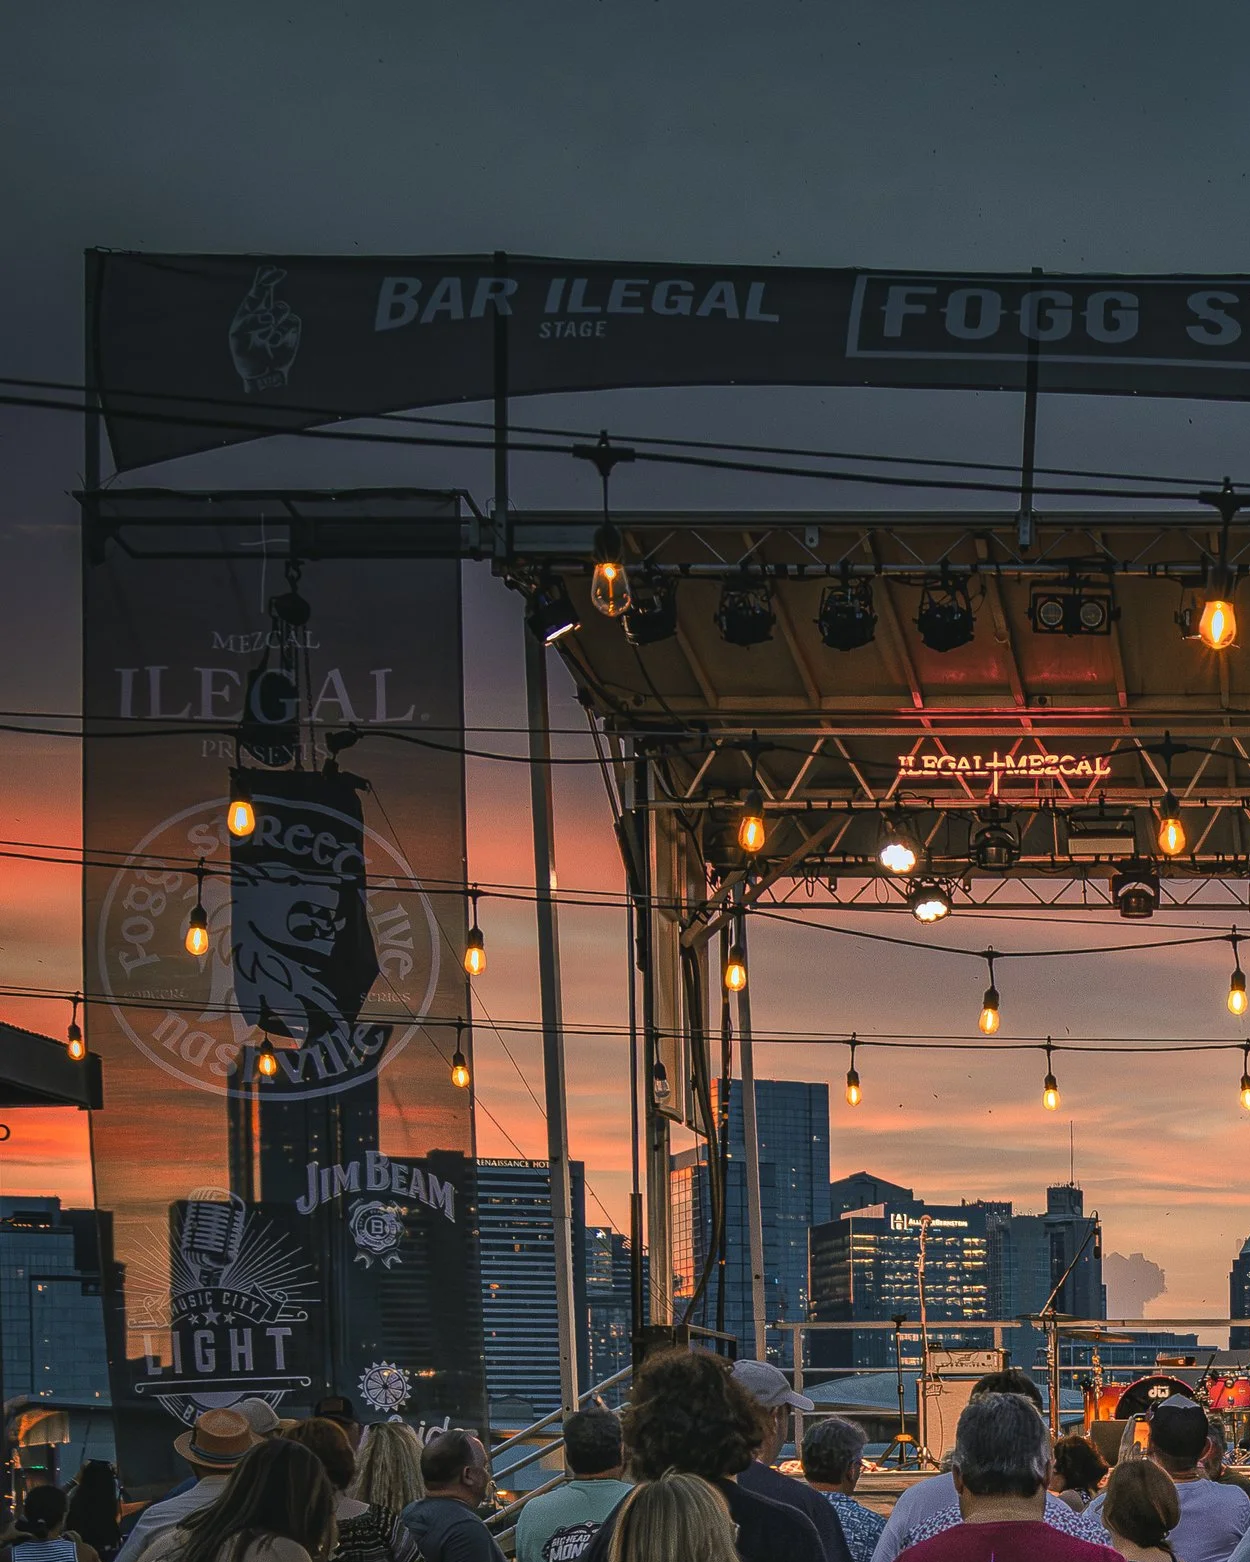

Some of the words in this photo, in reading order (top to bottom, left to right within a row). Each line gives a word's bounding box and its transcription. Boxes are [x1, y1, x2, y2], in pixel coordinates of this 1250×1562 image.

[374, 275, 518, 332] BAR
[543, 277, 780, 323] ILEGAL
[880, 284, 1141, 344] FOGG
[537, 319, 608, 340] STAGE
[210, 629, 321, 654] MEZCAL
[898, 755, 989, 776] ILEGAL
[1004, 754, 1112, 776] MEZCAL
[477, 1158, 530, 1169] RENAISSANCE
[296, 1159, 361, 1216] JIM
[364, 1149, 457, 1225] BEAM
[170, 1290, 214, 1315] MUSIC
[222, 1291, 261, 1315] CITY
[143, 1326, 293, 1376] LIGHT
[565, 1534, 591, 1544] HEAD
